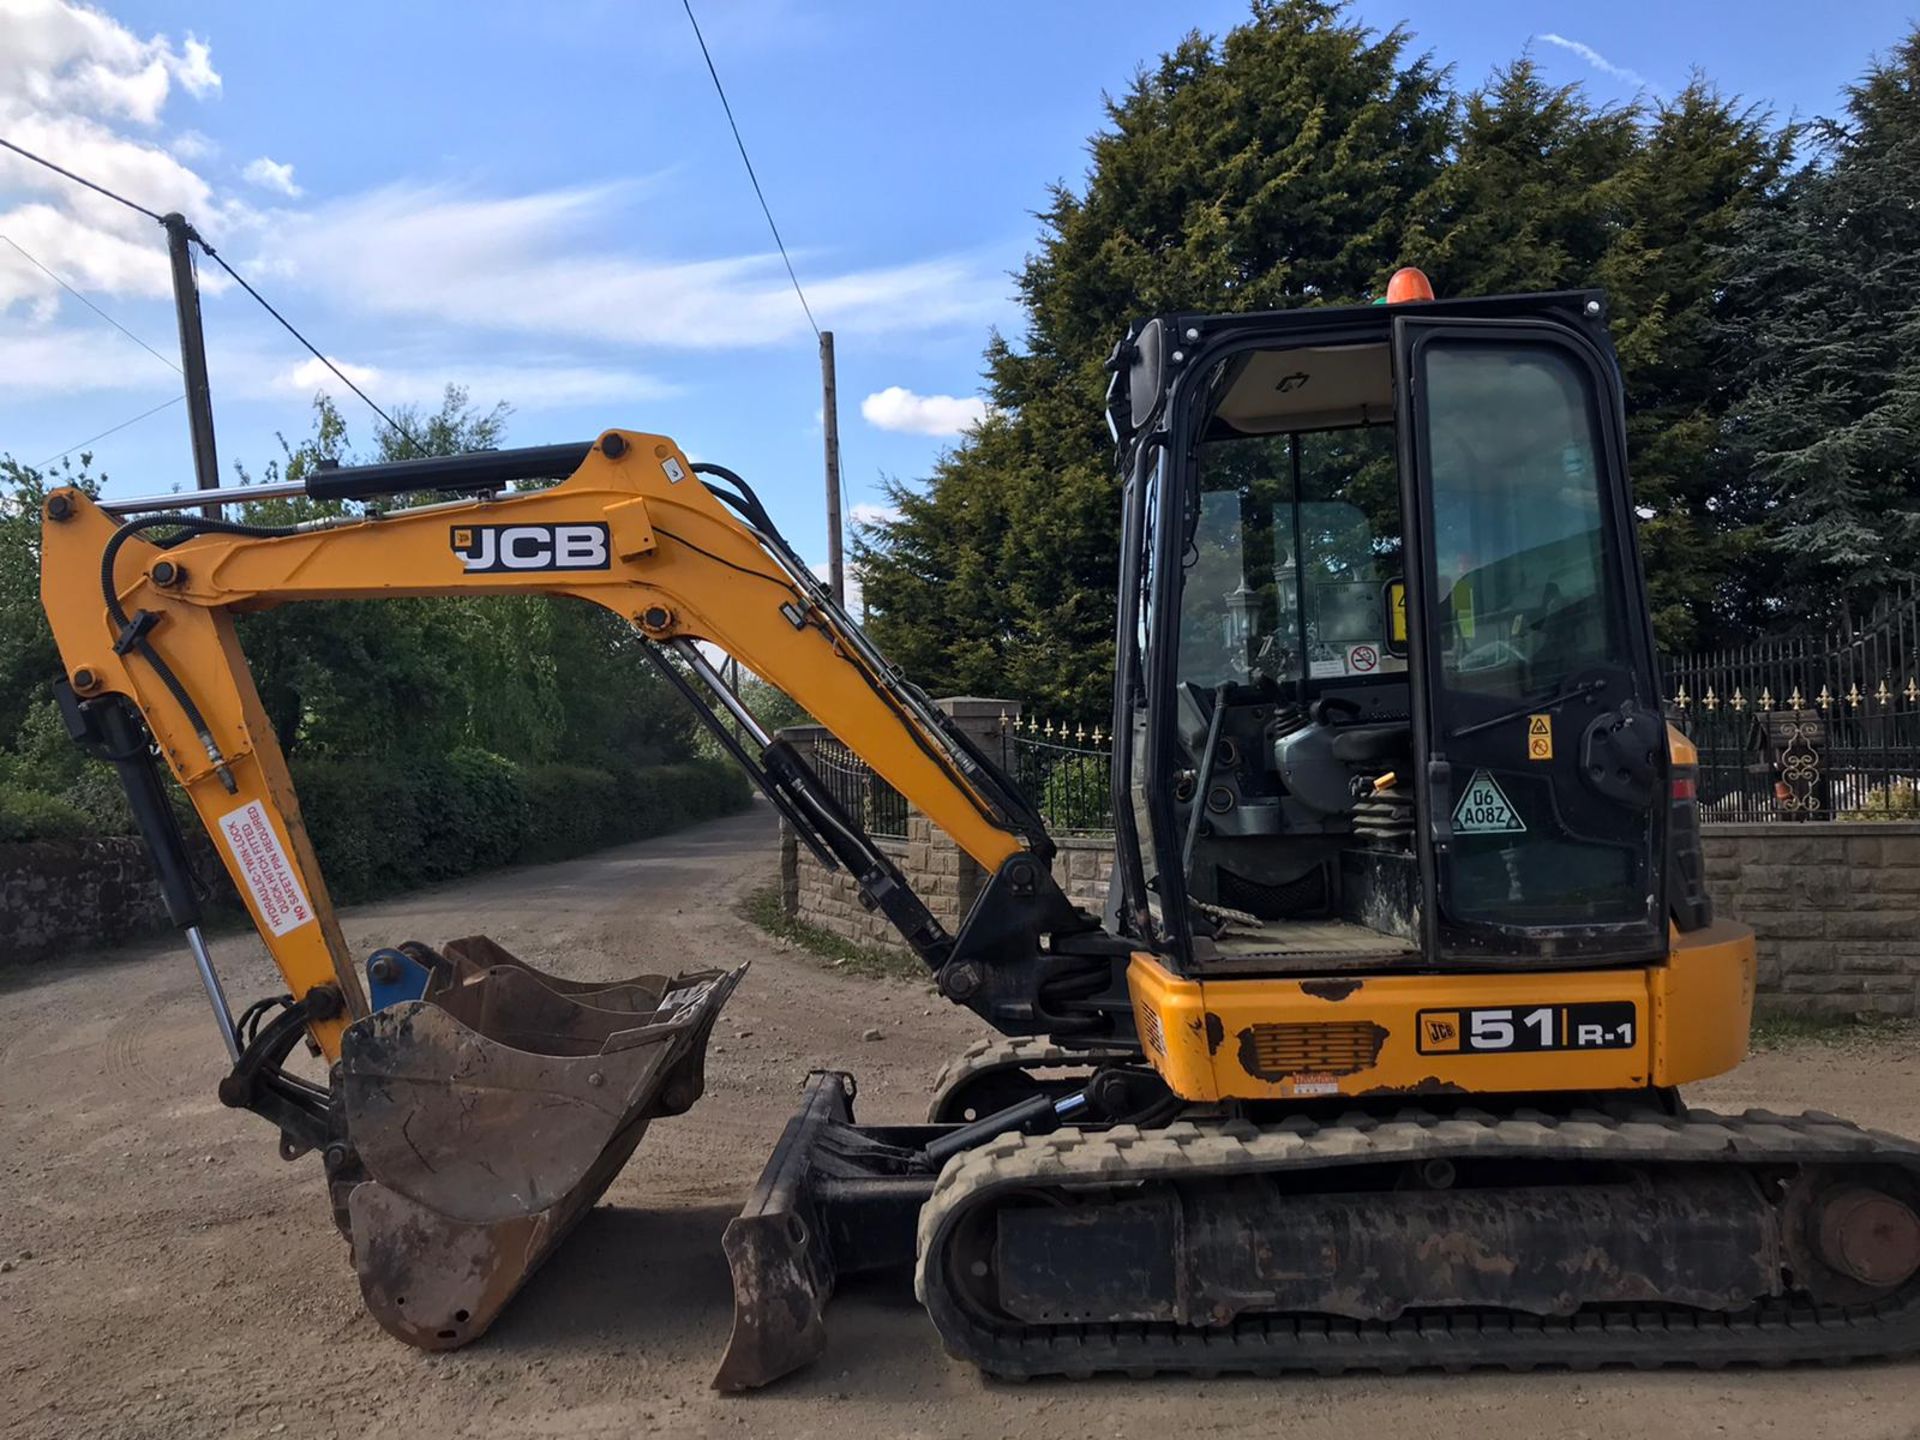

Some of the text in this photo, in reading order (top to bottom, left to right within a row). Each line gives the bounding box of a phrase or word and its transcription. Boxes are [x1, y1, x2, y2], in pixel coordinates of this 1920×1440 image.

[455, 526, 607, 569] JCB
[241, 823, 290, 914] QUICK HITCH FITTED
[247, 806, 307, 921] NO SAFETY PIN REQUIRED
[1428, 1008, 1632, 1049] JCB 51 R-1
